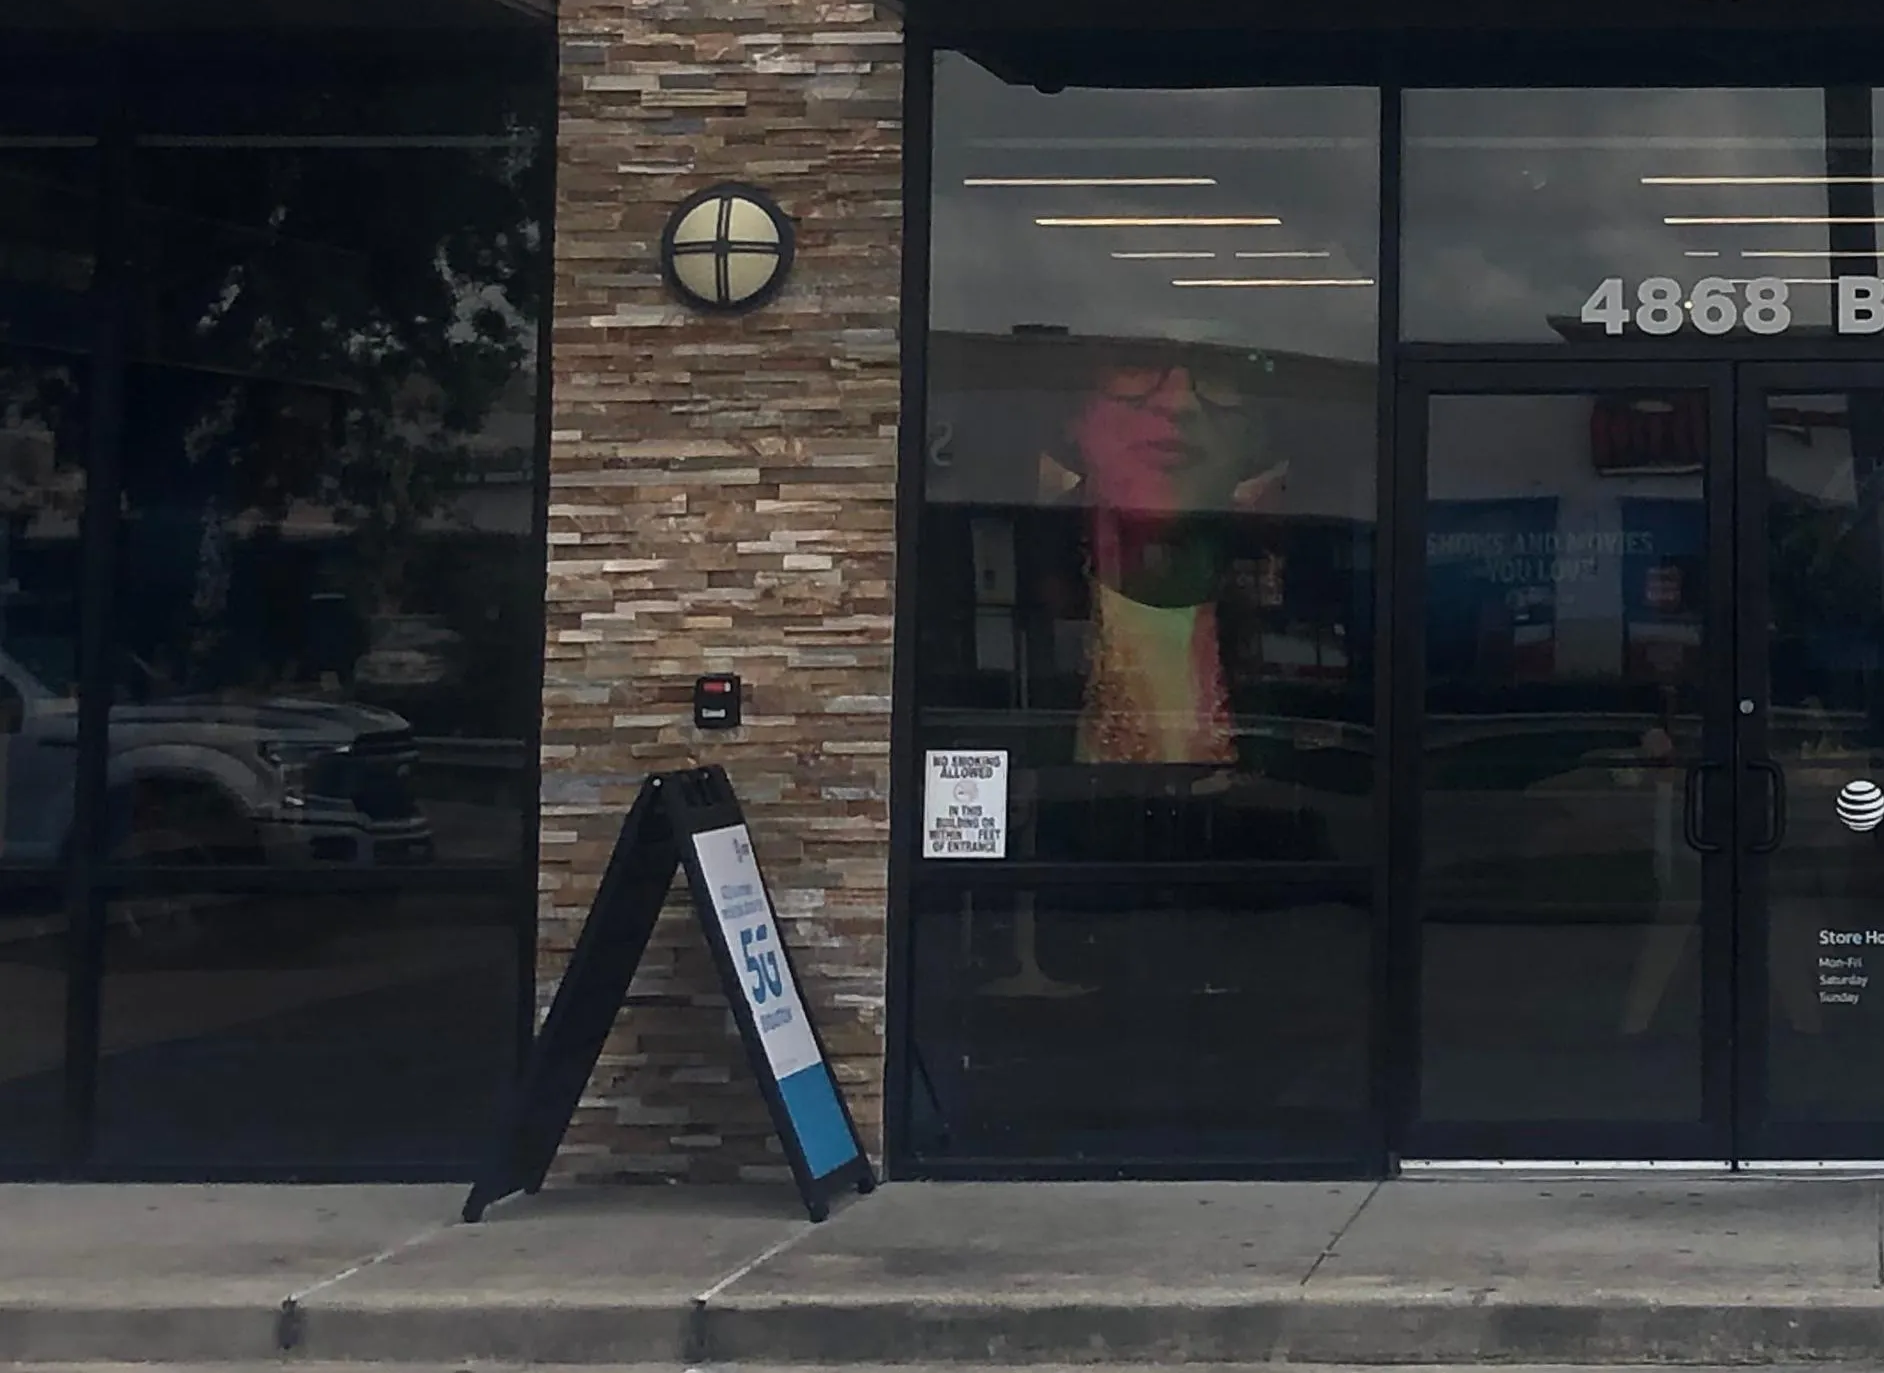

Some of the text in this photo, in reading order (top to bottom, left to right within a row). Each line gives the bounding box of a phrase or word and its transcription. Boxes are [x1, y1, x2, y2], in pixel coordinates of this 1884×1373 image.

[1581, 276, 1791, 335] 4868
[1515, 531, 1560, 555] AND
[933, 756, 1001, 768] NO SMOKING
[940, 767, 993, 779] ALLOWED
[949, 805, 983, 816] IN THIS
[978, 829, 1001, 840] FEET
[947, 841, 996, 853] ENTRANCE
[1819, 930, 1863, 945] Store
[740, 923, 783, 1005] 5G
[1819, 974, 1868, 987] Saturday
